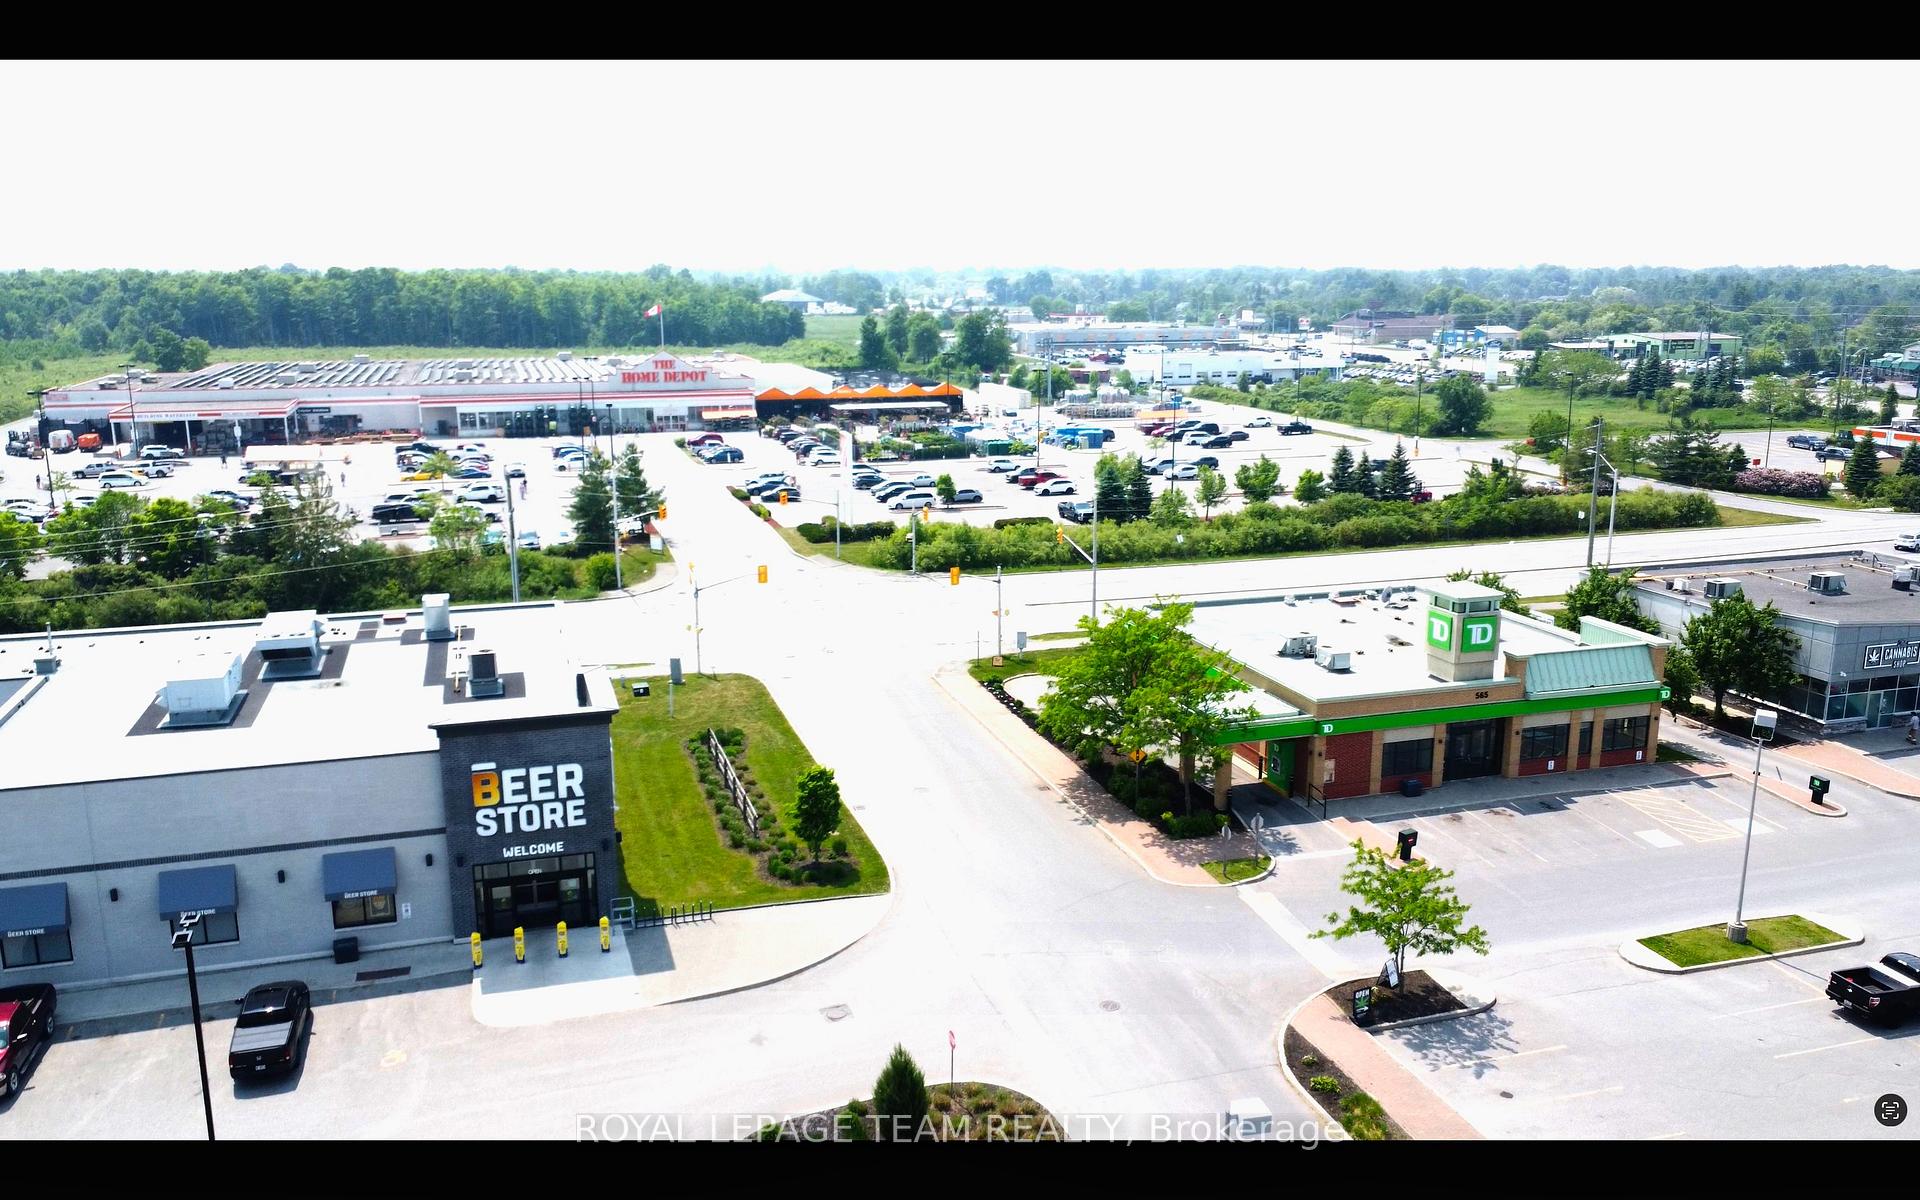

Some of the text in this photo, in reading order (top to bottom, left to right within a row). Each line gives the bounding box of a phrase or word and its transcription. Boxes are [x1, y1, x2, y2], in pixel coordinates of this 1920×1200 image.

[653, 360, 676, 369] THE
[622, 370, 707, 384] HOME DEPOT
[1430, 617, 1449, 642] TD
[1467, 623, 1493, 645] TD
[1884, 646, 1918, 660] CANNABIS
[1893, 660, 1907, 668] SHOP
[1660, 690, 1670, 699] TD
[1322, 724, 1334, 733] TD
[471, 762, 585, 807] BEER
[475, 799, 587, 837] STORE
[503, 842, 564, 858] WELCOME
[360, 889, 378, 897] STORE
[7, 928, 45, 938] BEER STORE
[1355, 988, 1370, 999] OPEN
